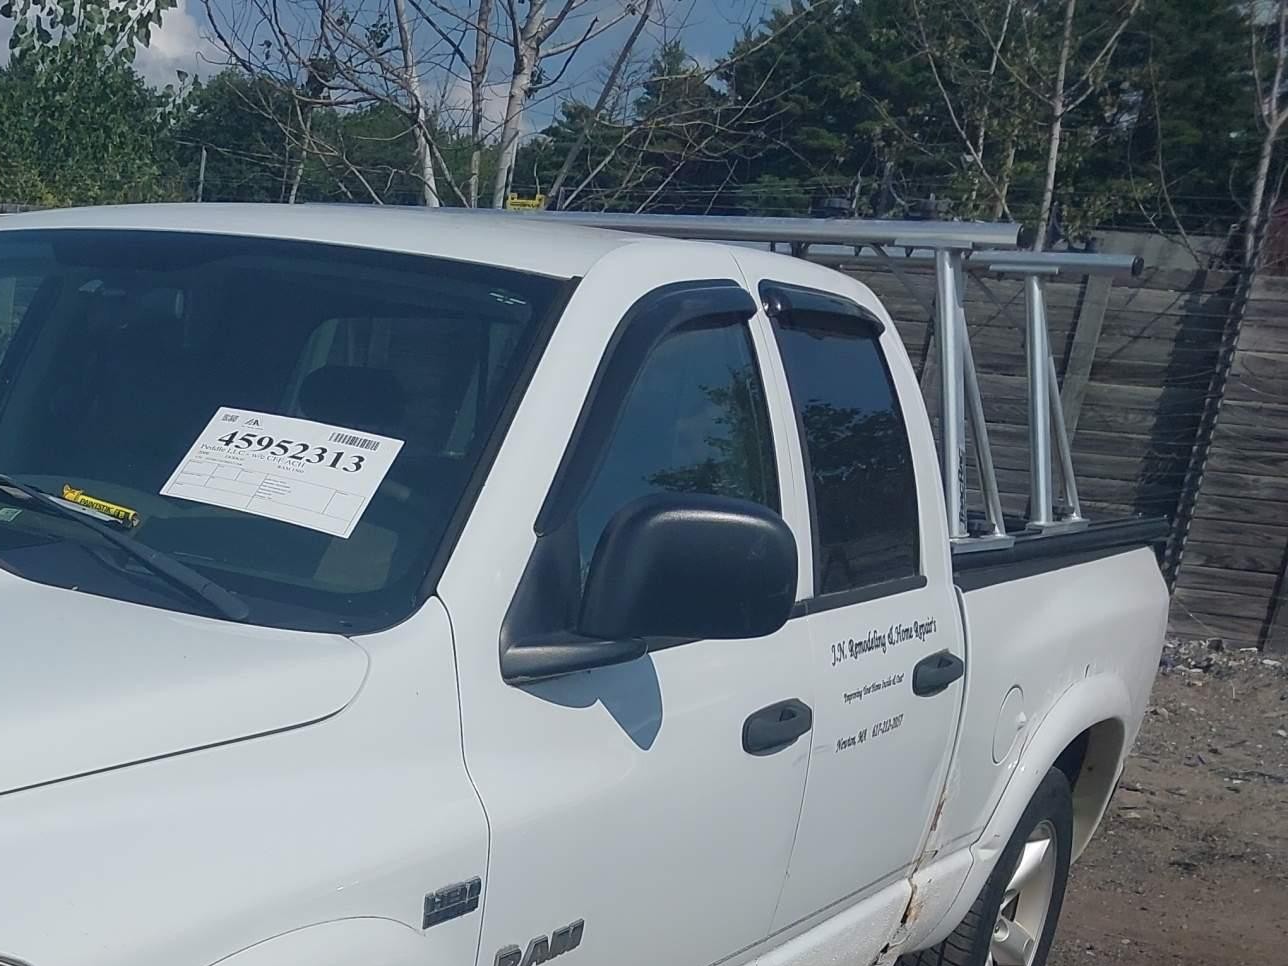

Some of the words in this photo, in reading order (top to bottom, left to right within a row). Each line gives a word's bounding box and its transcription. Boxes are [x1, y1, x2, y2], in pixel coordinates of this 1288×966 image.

[217, 430, 366, 474] 45952313
[848, 629, 887, 659] Remodeling
[895, 623, 913, 643] Home
